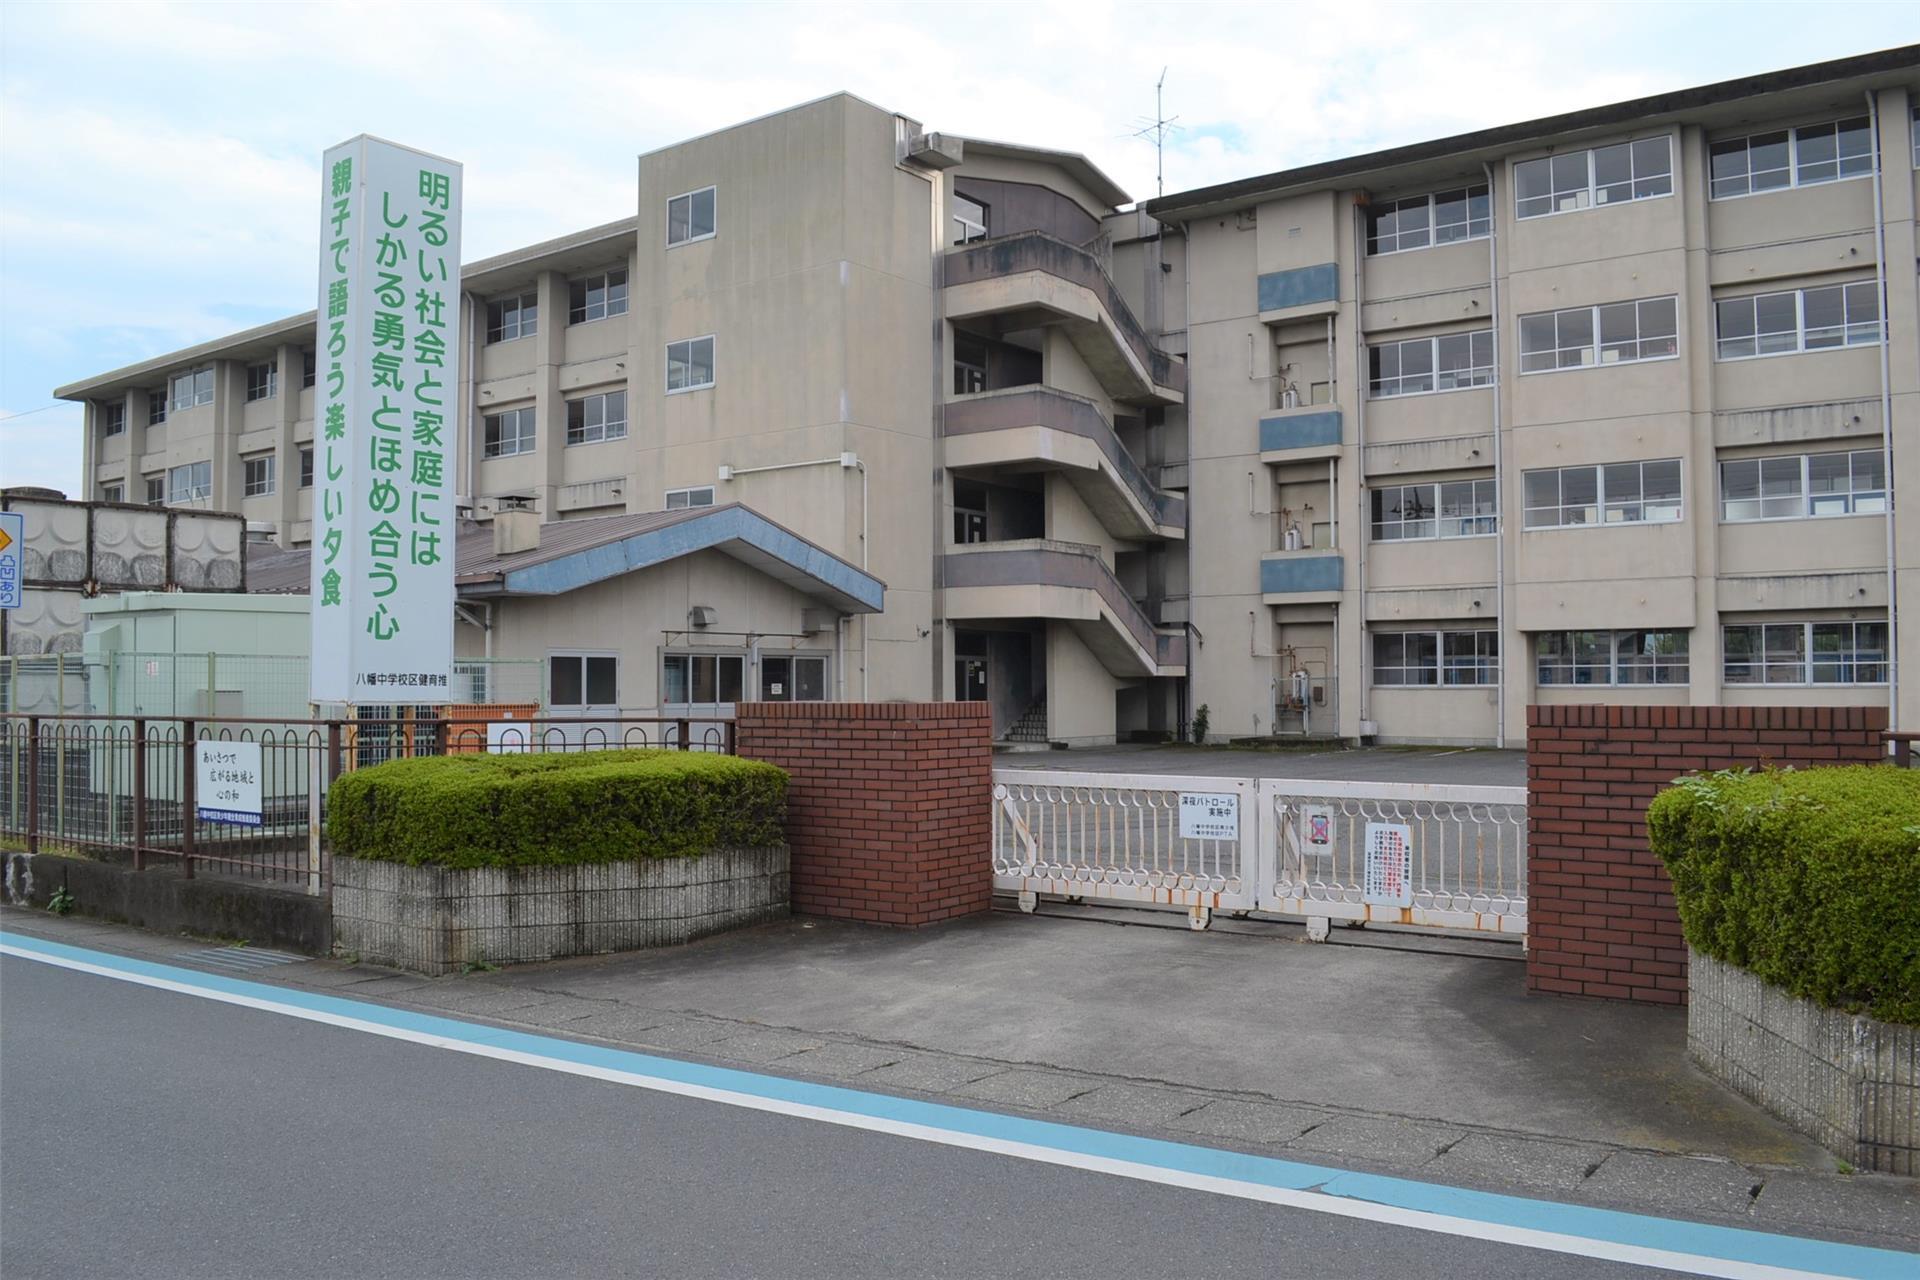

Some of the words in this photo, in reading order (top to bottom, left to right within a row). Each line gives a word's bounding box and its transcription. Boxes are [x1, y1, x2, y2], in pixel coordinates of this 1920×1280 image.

[411, 169, 450, 566] 明るい社会と家庭には
[321, 157, 352, 606] 親子で語ろう楽しい夕食
[367, 191, 408, 640] しかる勇気とほめ合う心
[356, 672, 448, 688] 八幡中学校区健育推
[203, 749, 237, 765] あいさつで
[210, 768, 255, 785] 広がる地域と
[1182, 796, 1234, 807] 深夜パトロール
[1208, 807, 1231, 817] 実施中
